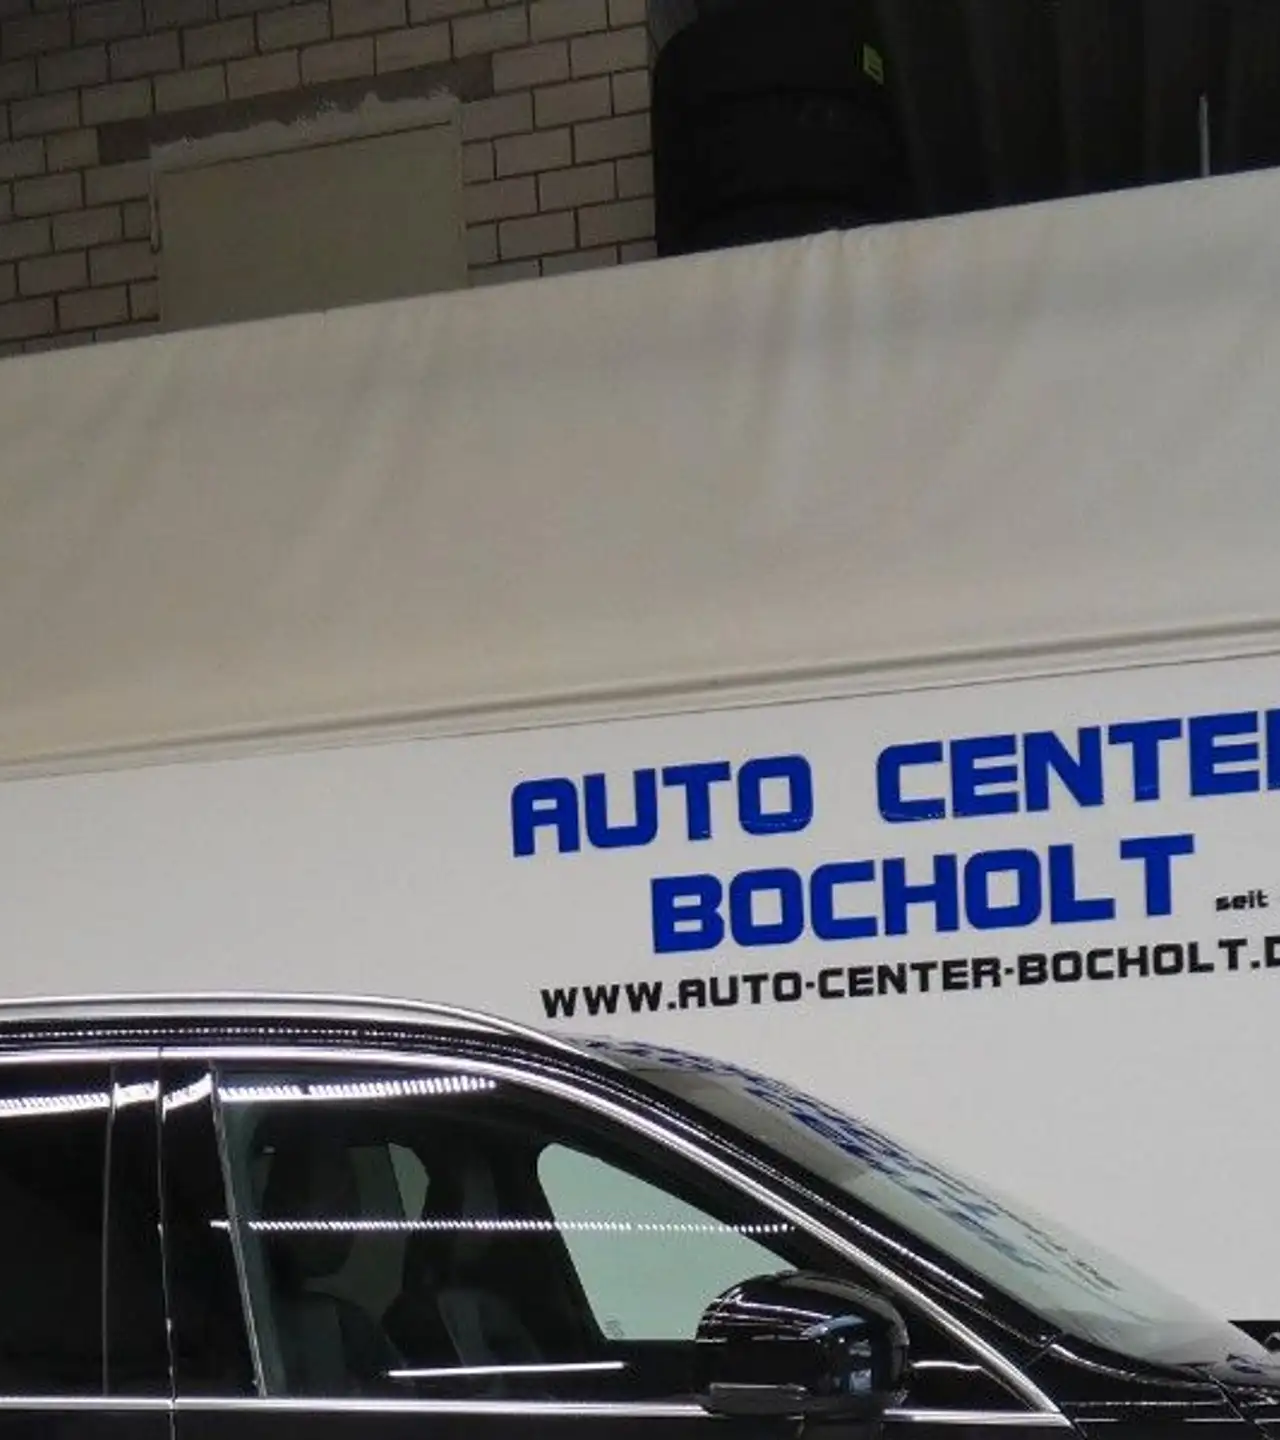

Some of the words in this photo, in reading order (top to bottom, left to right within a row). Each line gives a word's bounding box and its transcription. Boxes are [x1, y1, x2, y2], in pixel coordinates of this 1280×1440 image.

[511, 754, 815, 858] AUTO
[650, 833, 1197, 955] BOCHOLT
[1214, 889, 1270, 912] seit
